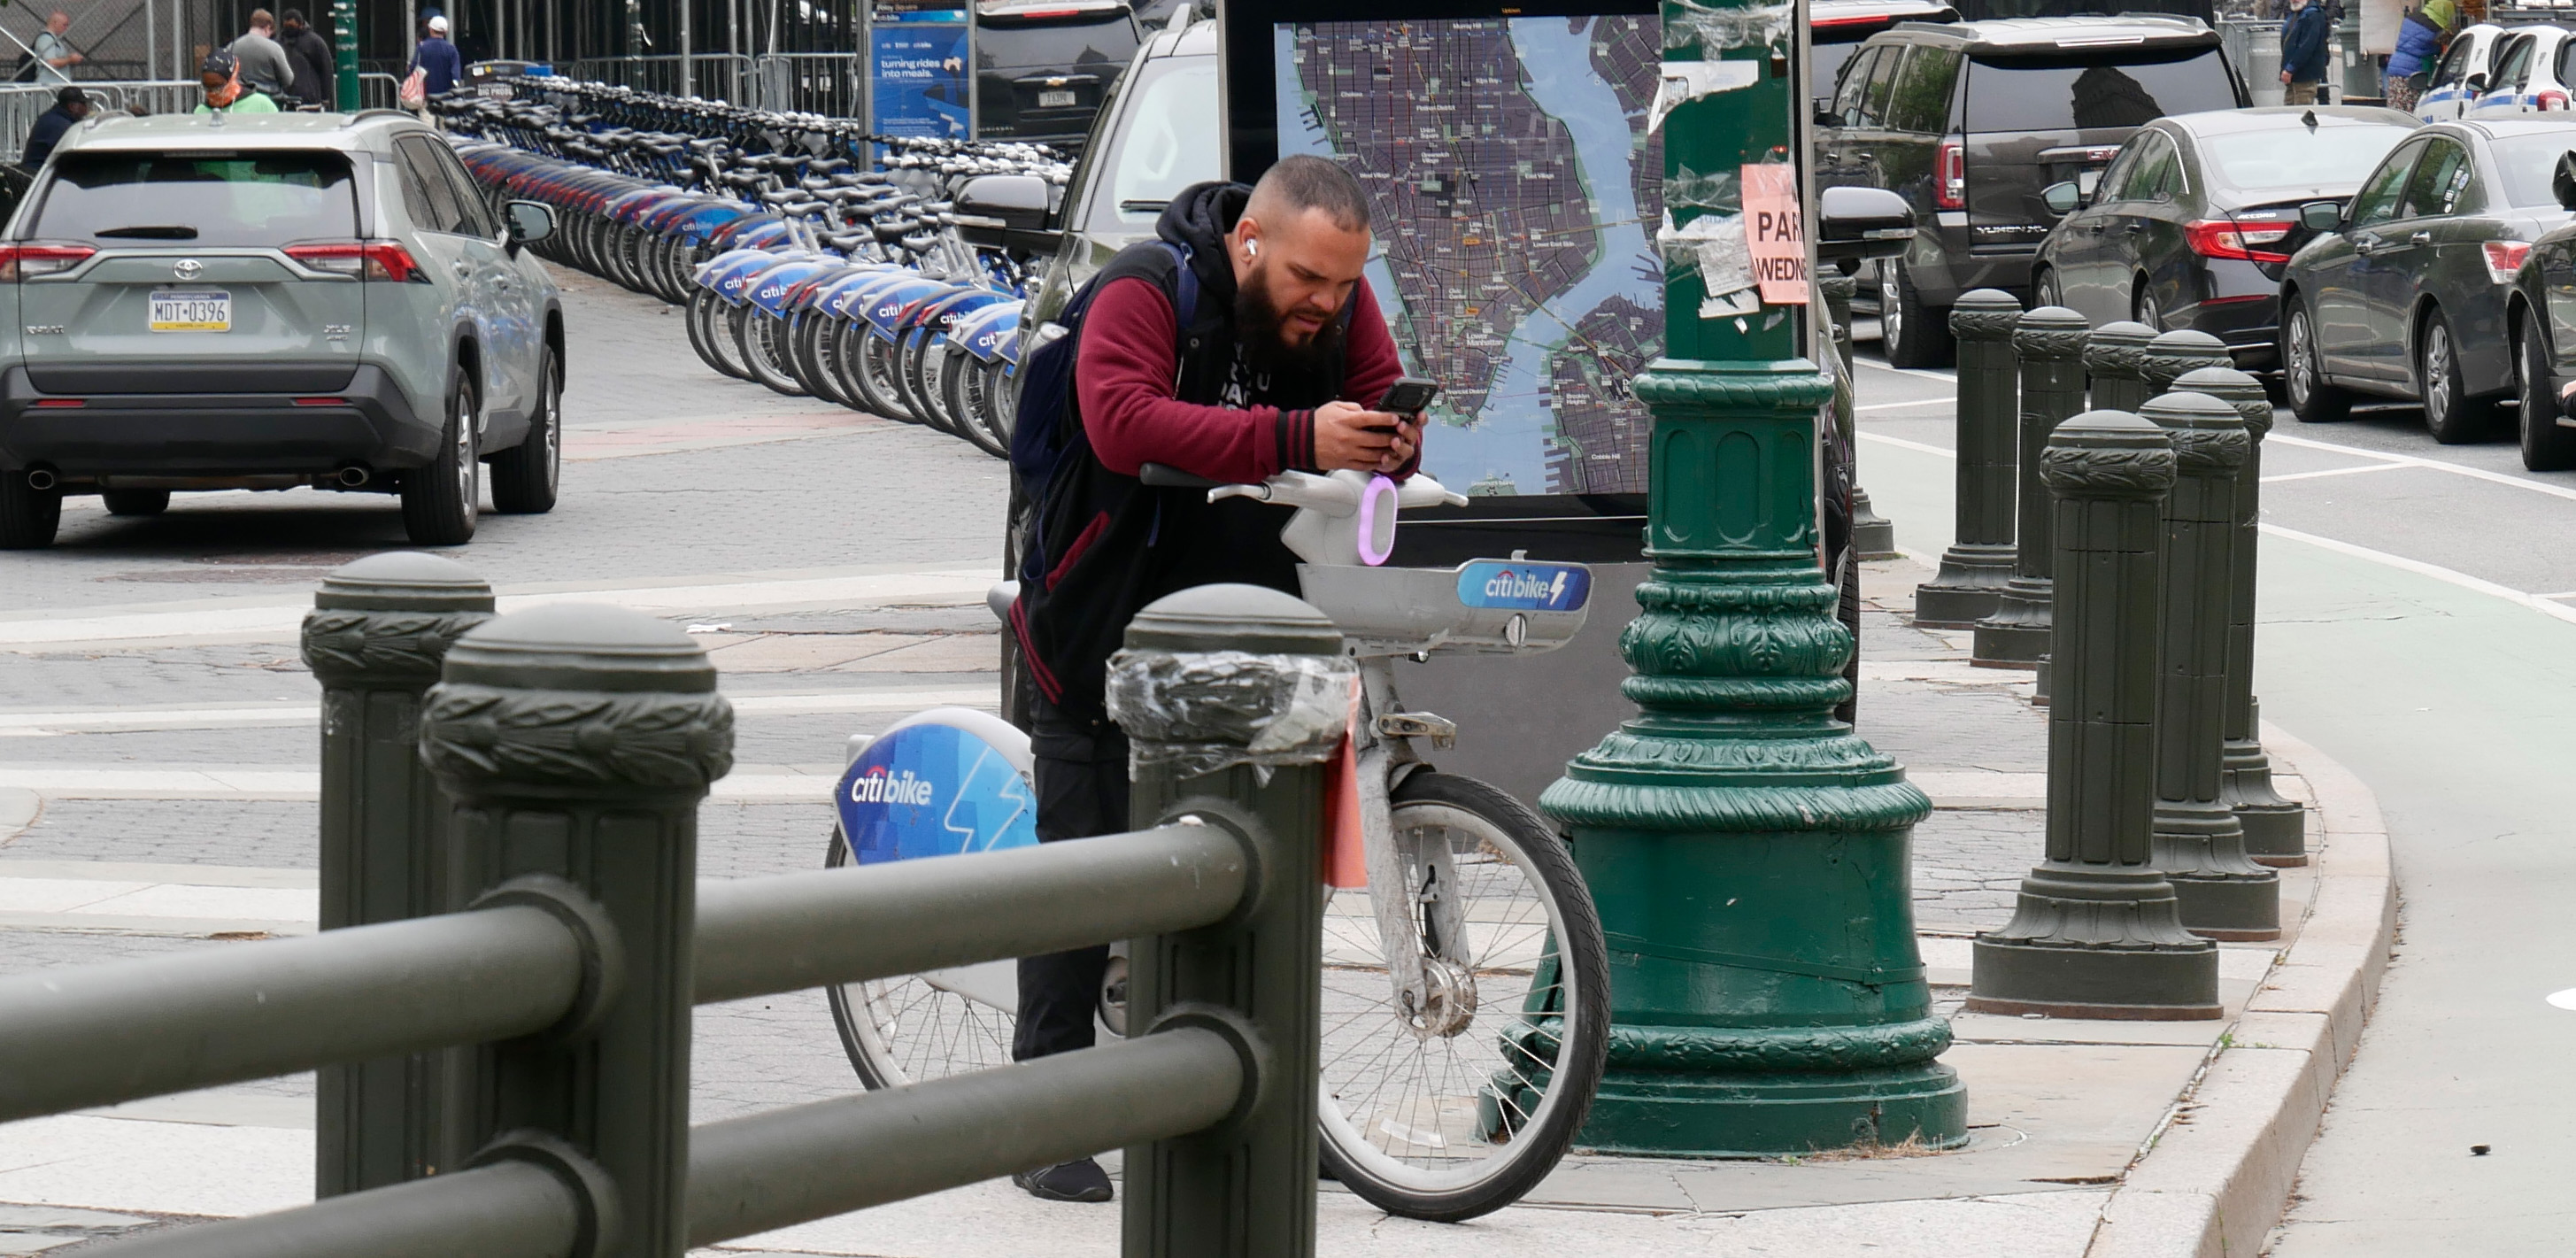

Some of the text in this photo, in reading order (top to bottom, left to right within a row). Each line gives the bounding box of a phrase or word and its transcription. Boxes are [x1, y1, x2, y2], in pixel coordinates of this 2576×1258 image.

[881, 58, 940, 70] turning rides
[882, 69, 933, 78] into meals.
[1758, 212, 1801, 242] PAR
[724, 276, 743, 290] citi
[761, 284, 780, 299] citi
[878, 304, 899, 318] citi
[940, 311, 957, 325] citi
[978, 332, 997, 347] cit
